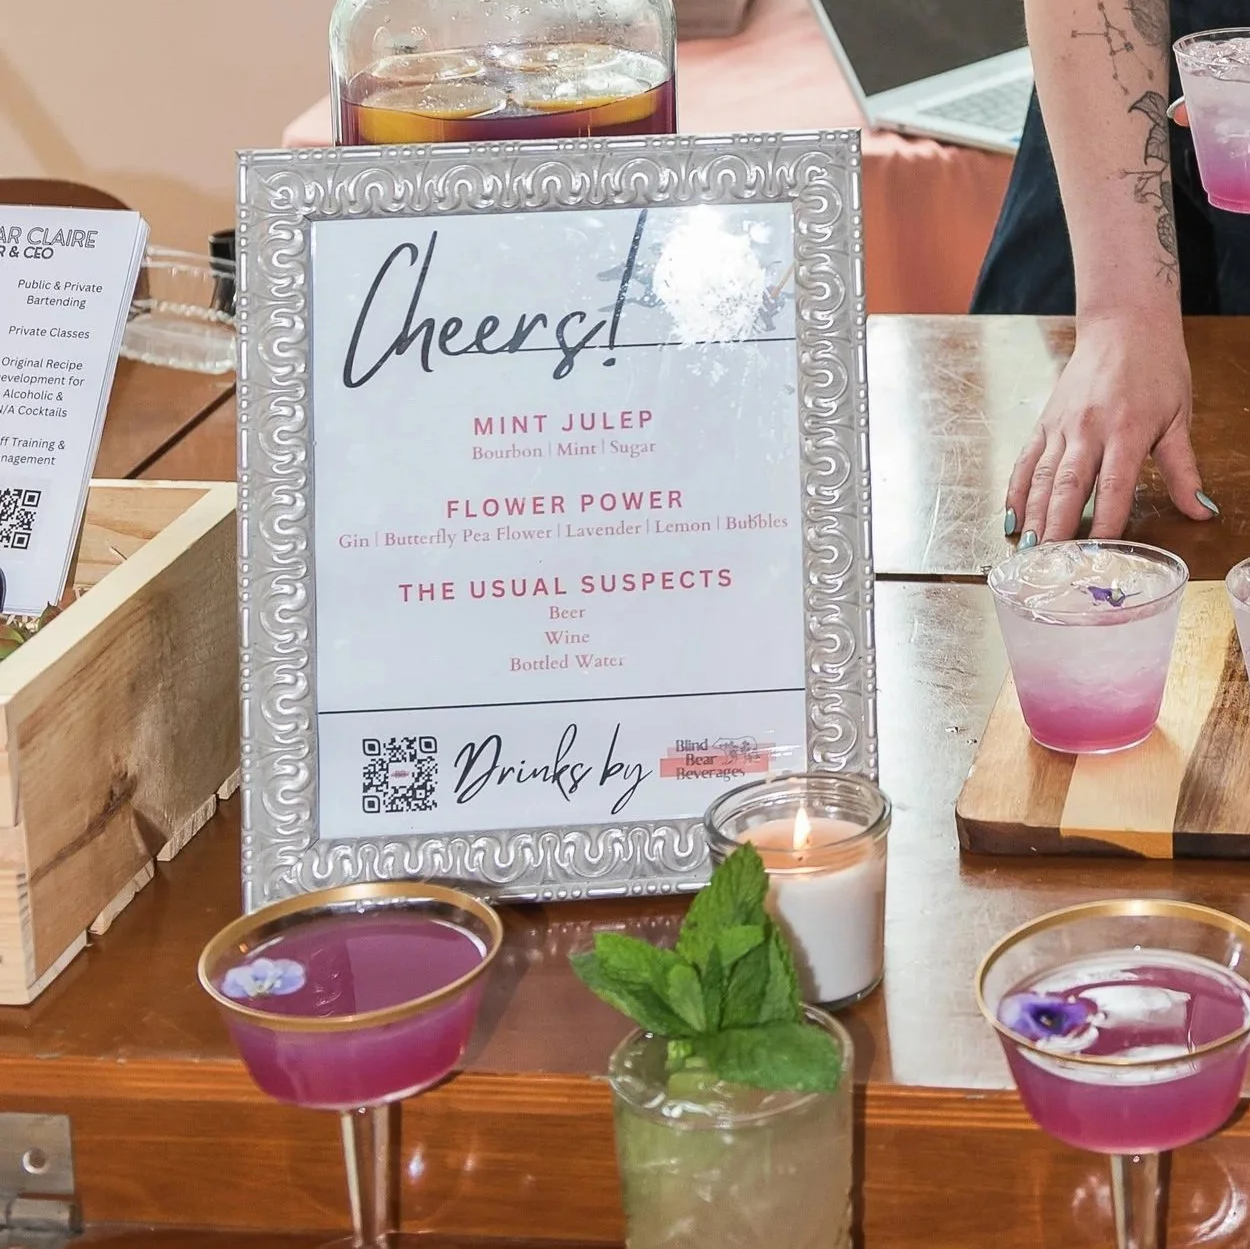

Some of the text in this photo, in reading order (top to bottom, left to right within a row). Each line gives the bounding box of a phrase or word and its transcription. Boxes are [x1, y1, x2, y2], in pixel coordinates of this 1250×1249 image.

[27, 227, 98, 248] CLAIRE
[9, 246, 19, 258] &
[23, 246, 54, 259] CEO
[18, 279, 103, 293] Public & Private
[27, 295, 86, 309] Bartending
[342, 209, 647, 389] Cheers!
[8, 325, 90, 339] Private Classes
[2, 356, 83, 372] Original Recipe
[0, 374, 85, 386] evelopment for
[3, 389, 63, 401] Alcoholic &
[18, 406, 68, 417] Cocktails
[474, 410, 653, 436] MINT JULEP
[12, 437, 55, 451] Training
[58, 440, 65, 450] &
[472, 440, 656, 460] Bourbon Mint Sugar
[447, 490, 683, 519] FLOWER POWER
[339, 514, 788, 549] Gin Butterfly Pea Flower Lavender Lemon Bubbles
[399, 568, 732, 602] THE USUAL SUSPECTS
[549, 606, 585, 620] Beer
[545, 630, 589, 645] Wine
[510, 654, 623, 672] Bottled Water
[676, 739, 708, 752] Blind
[686, 754, 717, 765] Bear
[454, 723, 652, 815] Drinks by
[676, 767, 745, 782] Beverages
